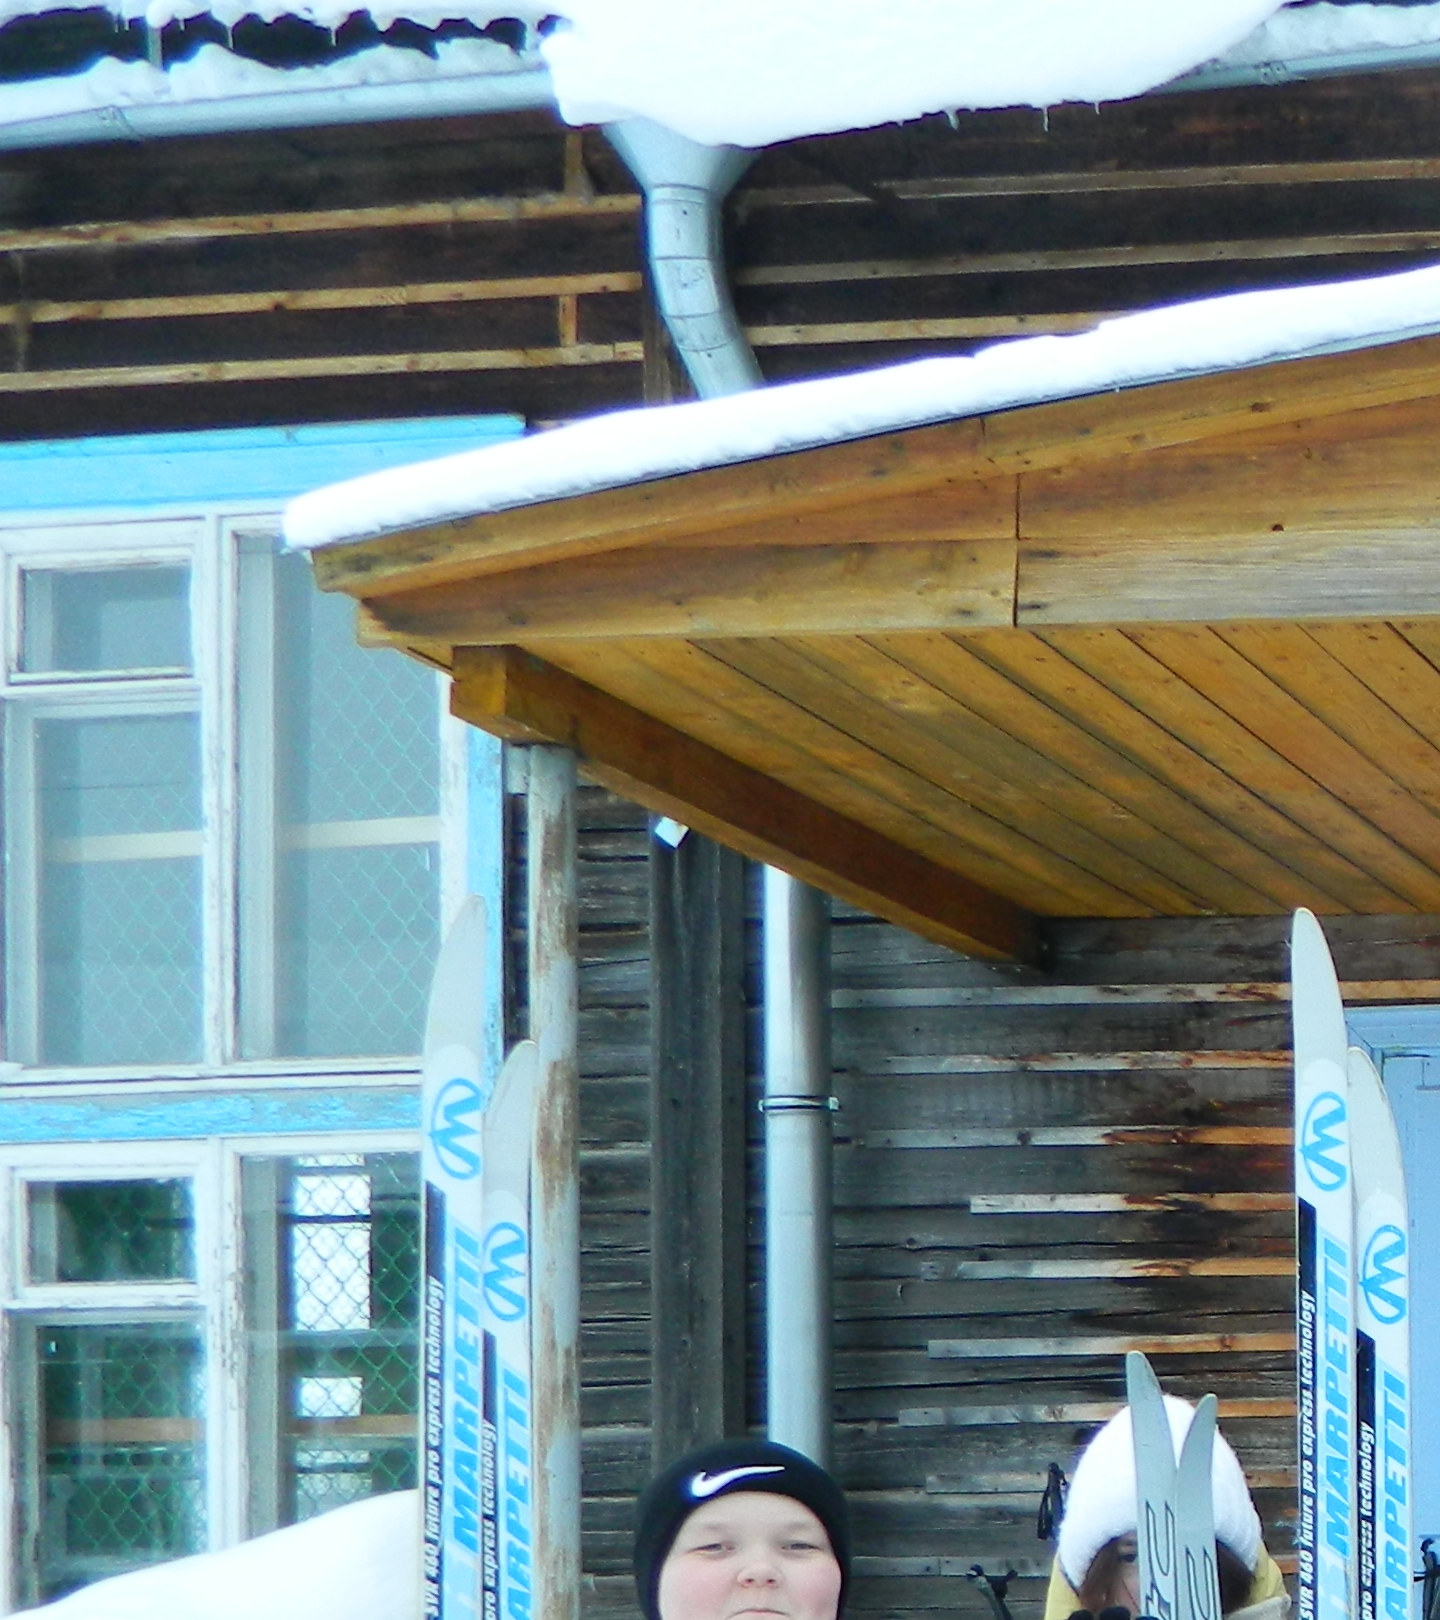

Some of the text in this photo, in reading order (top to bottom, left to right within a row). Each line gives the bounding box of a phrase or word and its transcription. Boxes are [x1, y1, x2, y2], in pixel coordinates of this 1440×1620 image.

[425, 1275, 443, 1373] technology
[1301, 1290, 1315, 1386] technology
[425, 1376, 443, 1447] express
[453, 1226, 480, 1555] MARPETTI
[1301, 1390, 1315, 1456] express
[1323, 1238, 1350, 1559] MARPETTI
[425, 1451, 442, 1484] pro
[482, 1418, 498, 1516] technology
[1301, 1459, 1315, 1494] pro
[1358, 1421, 1374, 1517] technology
[424, 1487, 441, 1540] future
[1300, 1496, 1314, 1548] future
[482, 1518, 498, 1588] express
[1300, 1552, 1314, 1585] 460
[1360, 1520, 1374, 1588] express
